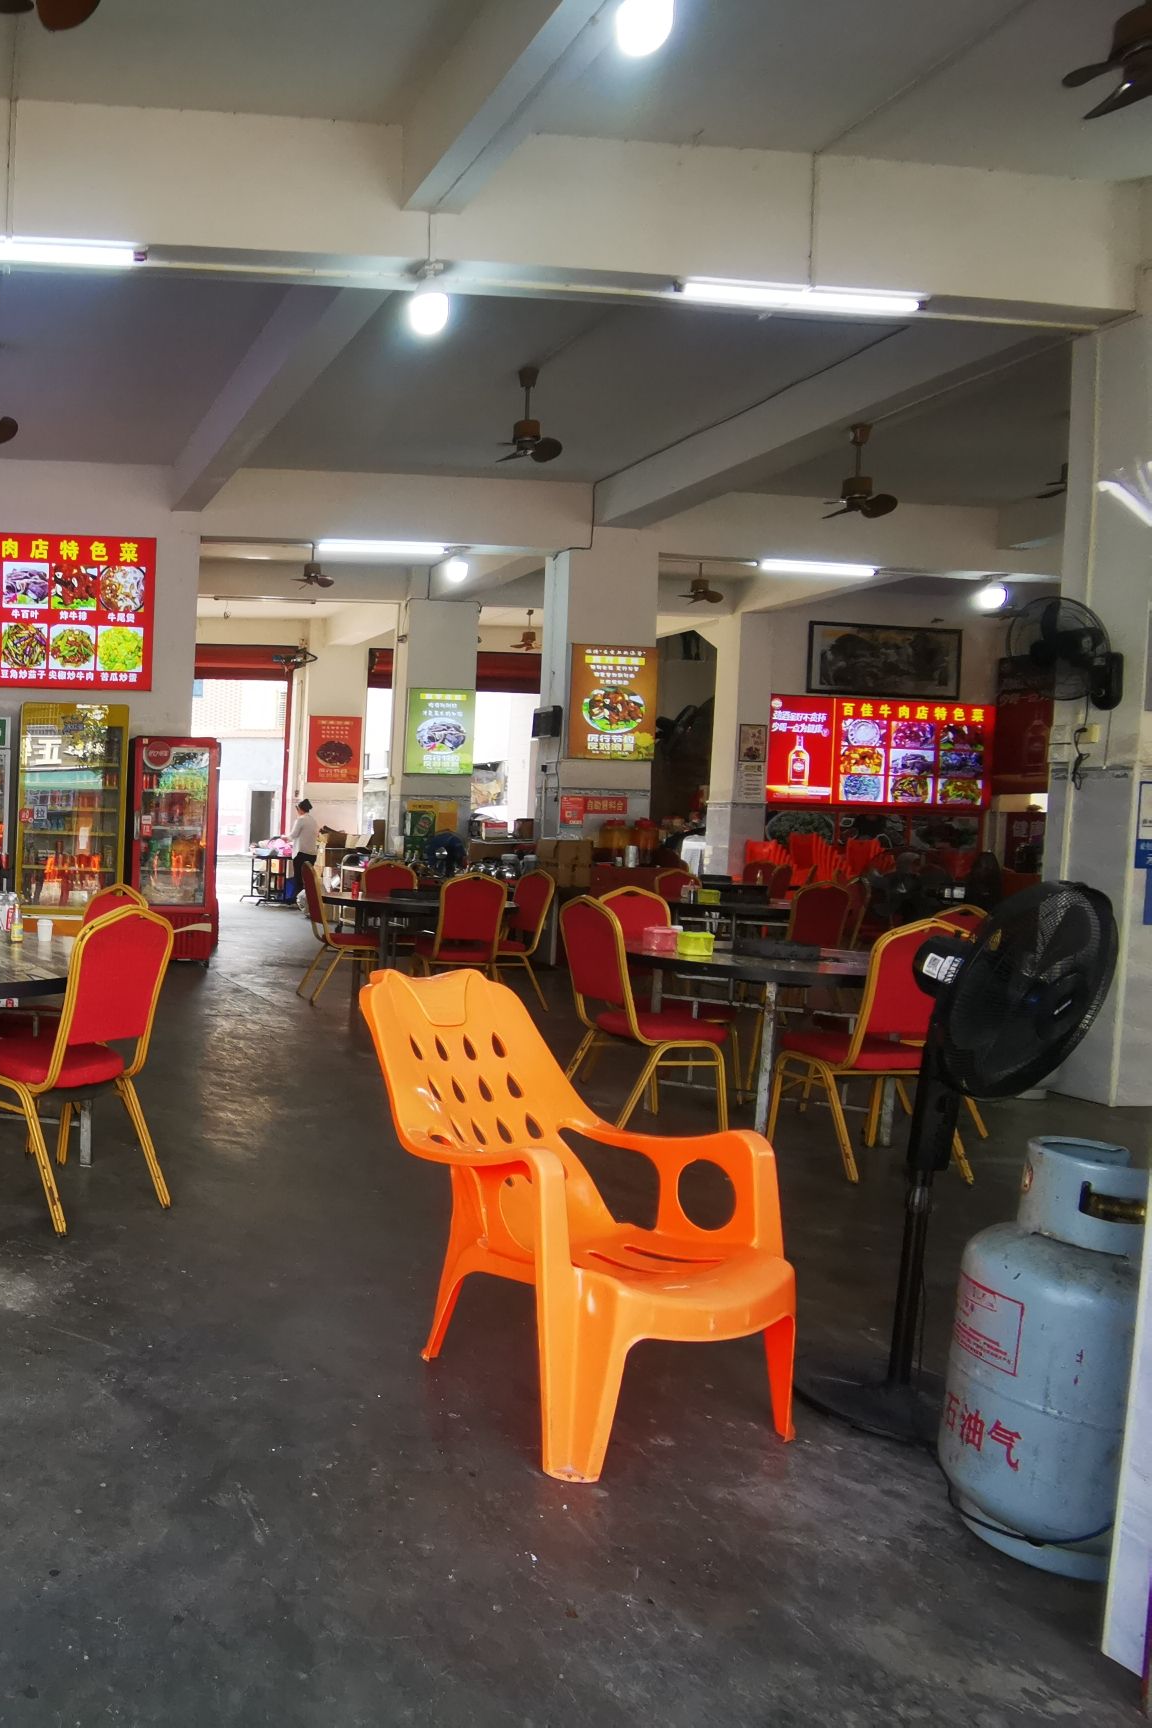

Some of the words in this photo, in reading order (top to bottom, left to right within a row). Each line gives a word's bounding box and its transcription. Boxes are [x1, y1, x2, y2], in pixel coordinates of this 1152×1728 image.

[11, 609, 39, 619] 牛百叶
[0, 669, 46, 680] 豆角炒茄子
[48, 671, 94, 681] 尖椒炒牛肉
[841, 702, 985, 722] 百佳牛肉店特色菜
[944, 1390, 1023, 1472] 石油气
